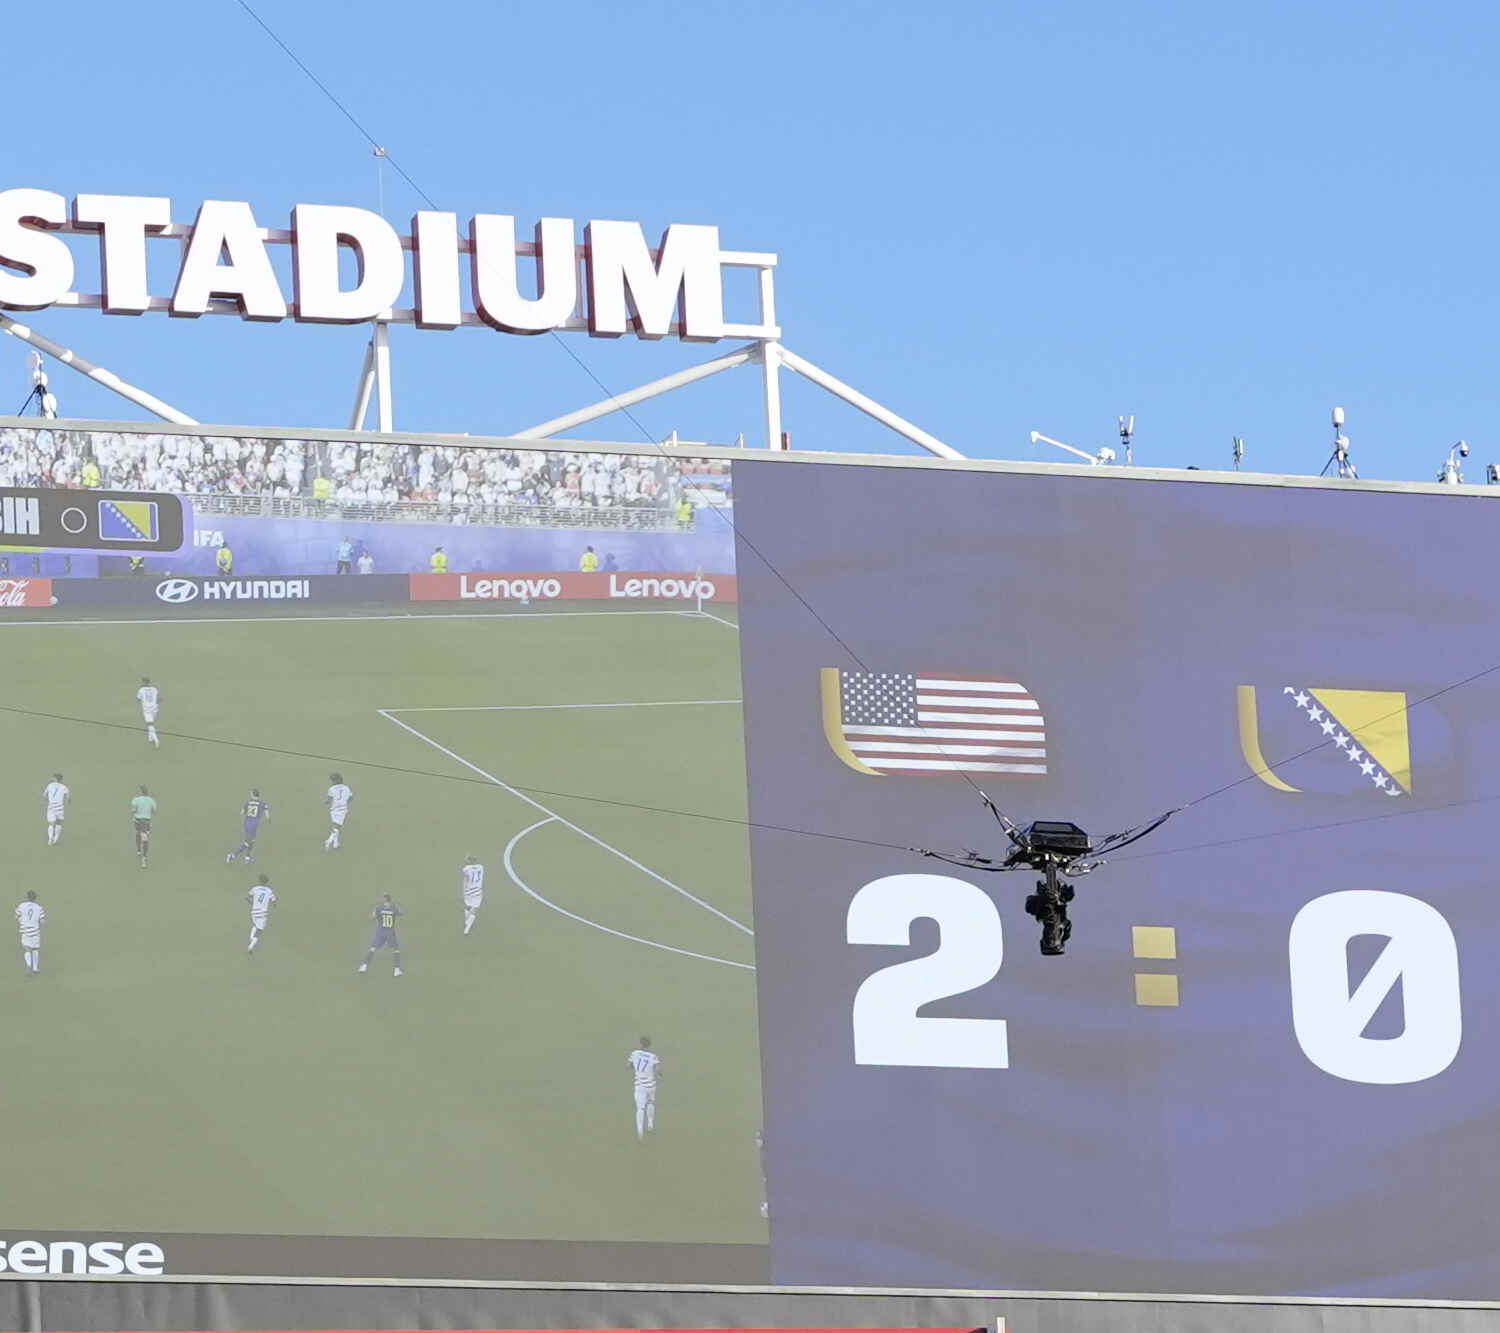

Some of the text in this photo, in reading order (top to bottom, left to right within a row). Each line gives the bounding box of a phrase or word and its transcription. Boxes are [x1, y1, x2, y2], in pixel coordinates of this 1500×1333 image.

[193, 530, 225, 547] IFA
[203, 580, 310, 600] HYUNDAI
[460, 575, 561, 600] Lenovo
[609, 574, 716, 600] Lenovo
[845, 873, 1009, 1069] 2
[1288, 889, 1463, 1084] 0
